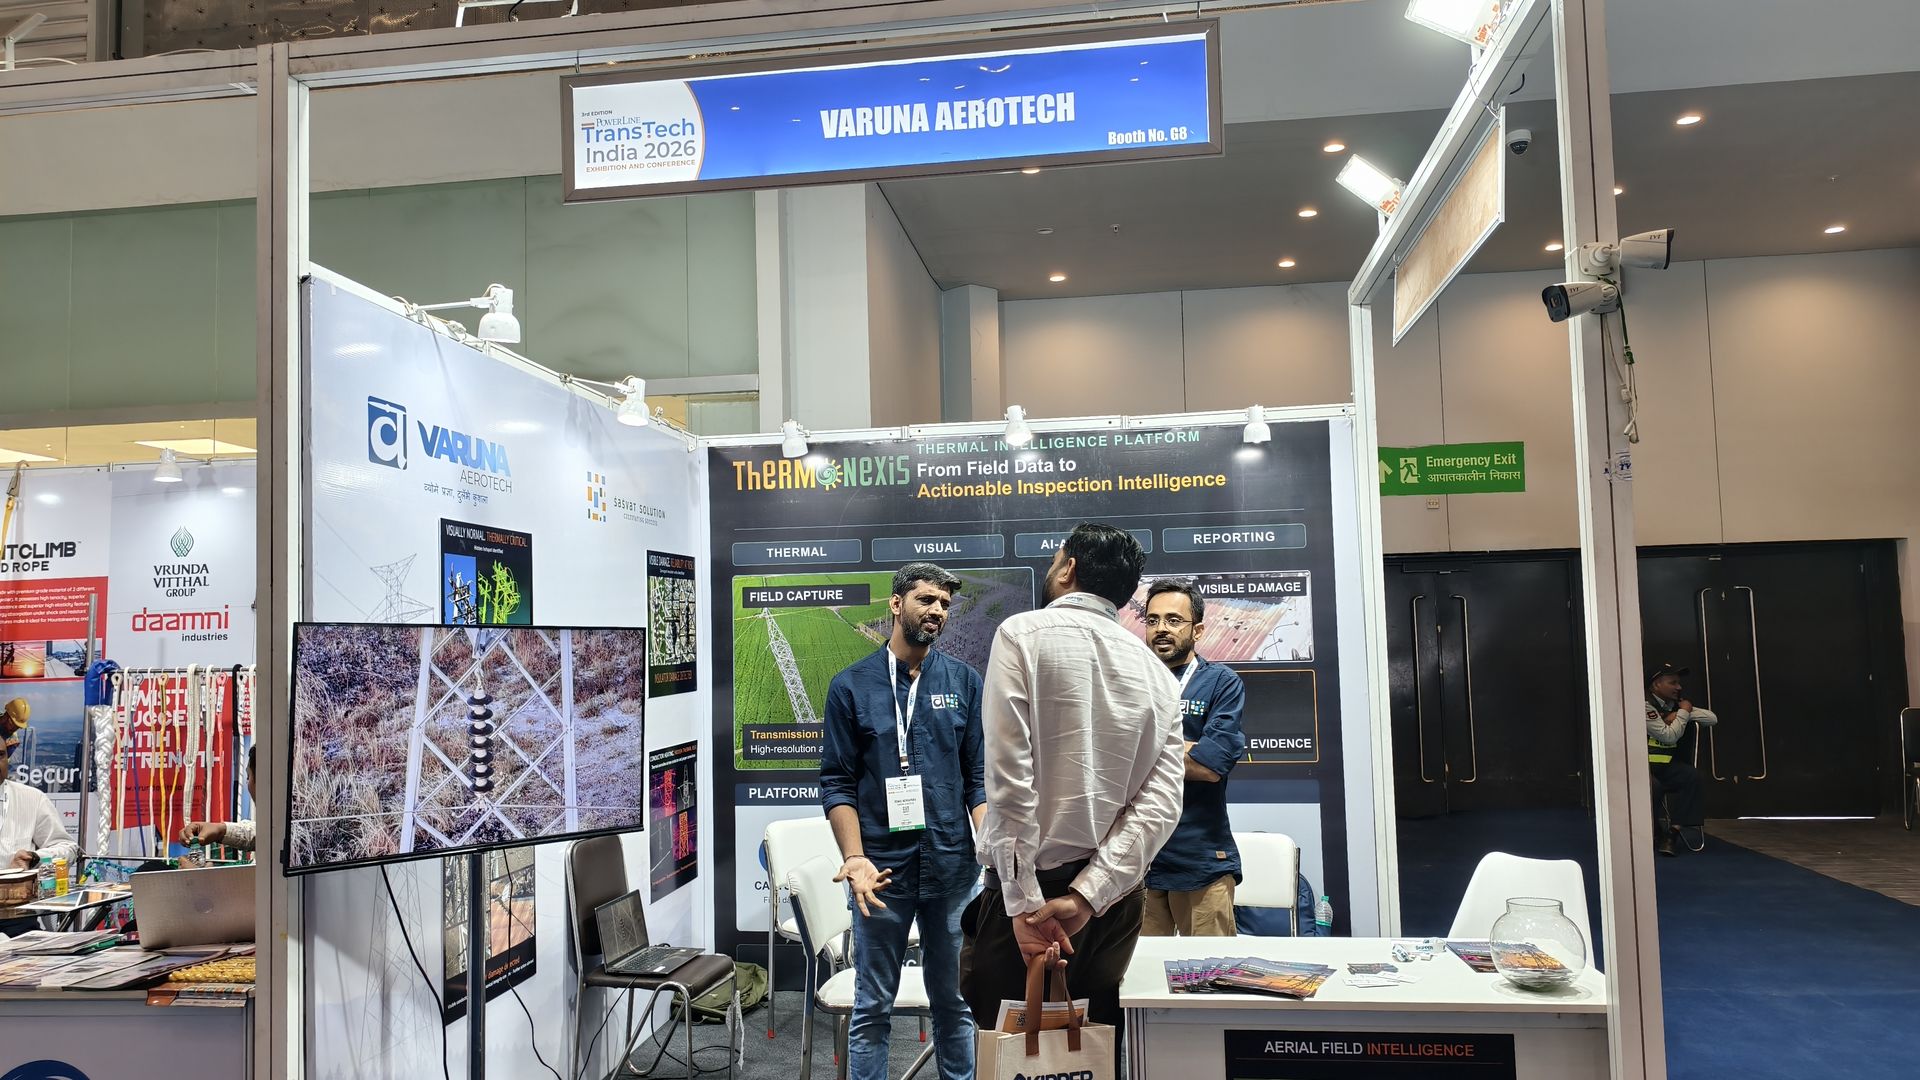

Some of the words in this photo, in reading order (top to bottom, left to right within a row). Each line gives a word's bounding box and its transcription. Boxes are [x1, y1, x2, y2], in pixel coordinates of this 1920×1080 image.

[820, 103, 930, 139] VARUNA
[935, 91, 1076, 132] AEROTECH
[581, 118, 695, 143] TransTech
[1107, 131, 1146, 146] Booth
[1149, 129, 1168, 143] No.
[1170, 126, 1188, 142] G8
[586, 144, 638, 163] India
[644, 140, 696, 159] 2026
[646, 160, 696, 169] CONFERENCE
[417, 420, 511, 477] VARUNA
[916, 441, 988, 454] THERMAL
[1114, 430, 1200, 446] PLATFORM
[1426, 456, 1490, 468] Emergency
[1493, 453, 1517, 464] Exit
[917, 463, 962, 478] From
[967, 460, 1009, 476] Field
[1014, 458, 1054, 474] Data
[1059, 457, 1077, 472] to
[460, 470, 513, 493] AEROTECH
[1427, 469, 1486, 482] आपातकालीन
[1489, 469, 1521, 480] निकास
[917, 480, 1012, 498] Actionable
[1017, 476, 1113, 497] Inspection
[1118, 473, 1227, 492] Intelligence
[1193, 531, 1275, 545] REPORTING
[766, 546, 827, 558] THERMAL
[913, 542, 962, 554] VISUAL
[12, 561, 50, 572] ROPE
[153, 563, 210, 576] VRUNDA
[153, 576, 210, 588] VITTHAL
[1198, 584, 1245, 594] VISIBLE
[1248, 581, 1301, 593] DAMAGE
[166, 588, 196, 597] GROUP
[750, 590, 784, 602] FIELD
[786, 589, 843, 601] CAPTURE
[132, 604, 229, 632] daamni
[181, 633, 228, 641] industries
[750, 729, 818, 739] Transmission
[750, 744, 816, 755] High-resolution
[1250, 738, 1312, 749] EVIDENCE
[749, 787, 819, 799] PLATFORM
[1264, 1041, 1318, 1054] AERIAL
[1321, 1042, 1363, 1055] FIELD
[1367, 1043, 1475, 1057] INTELLIGENCE
